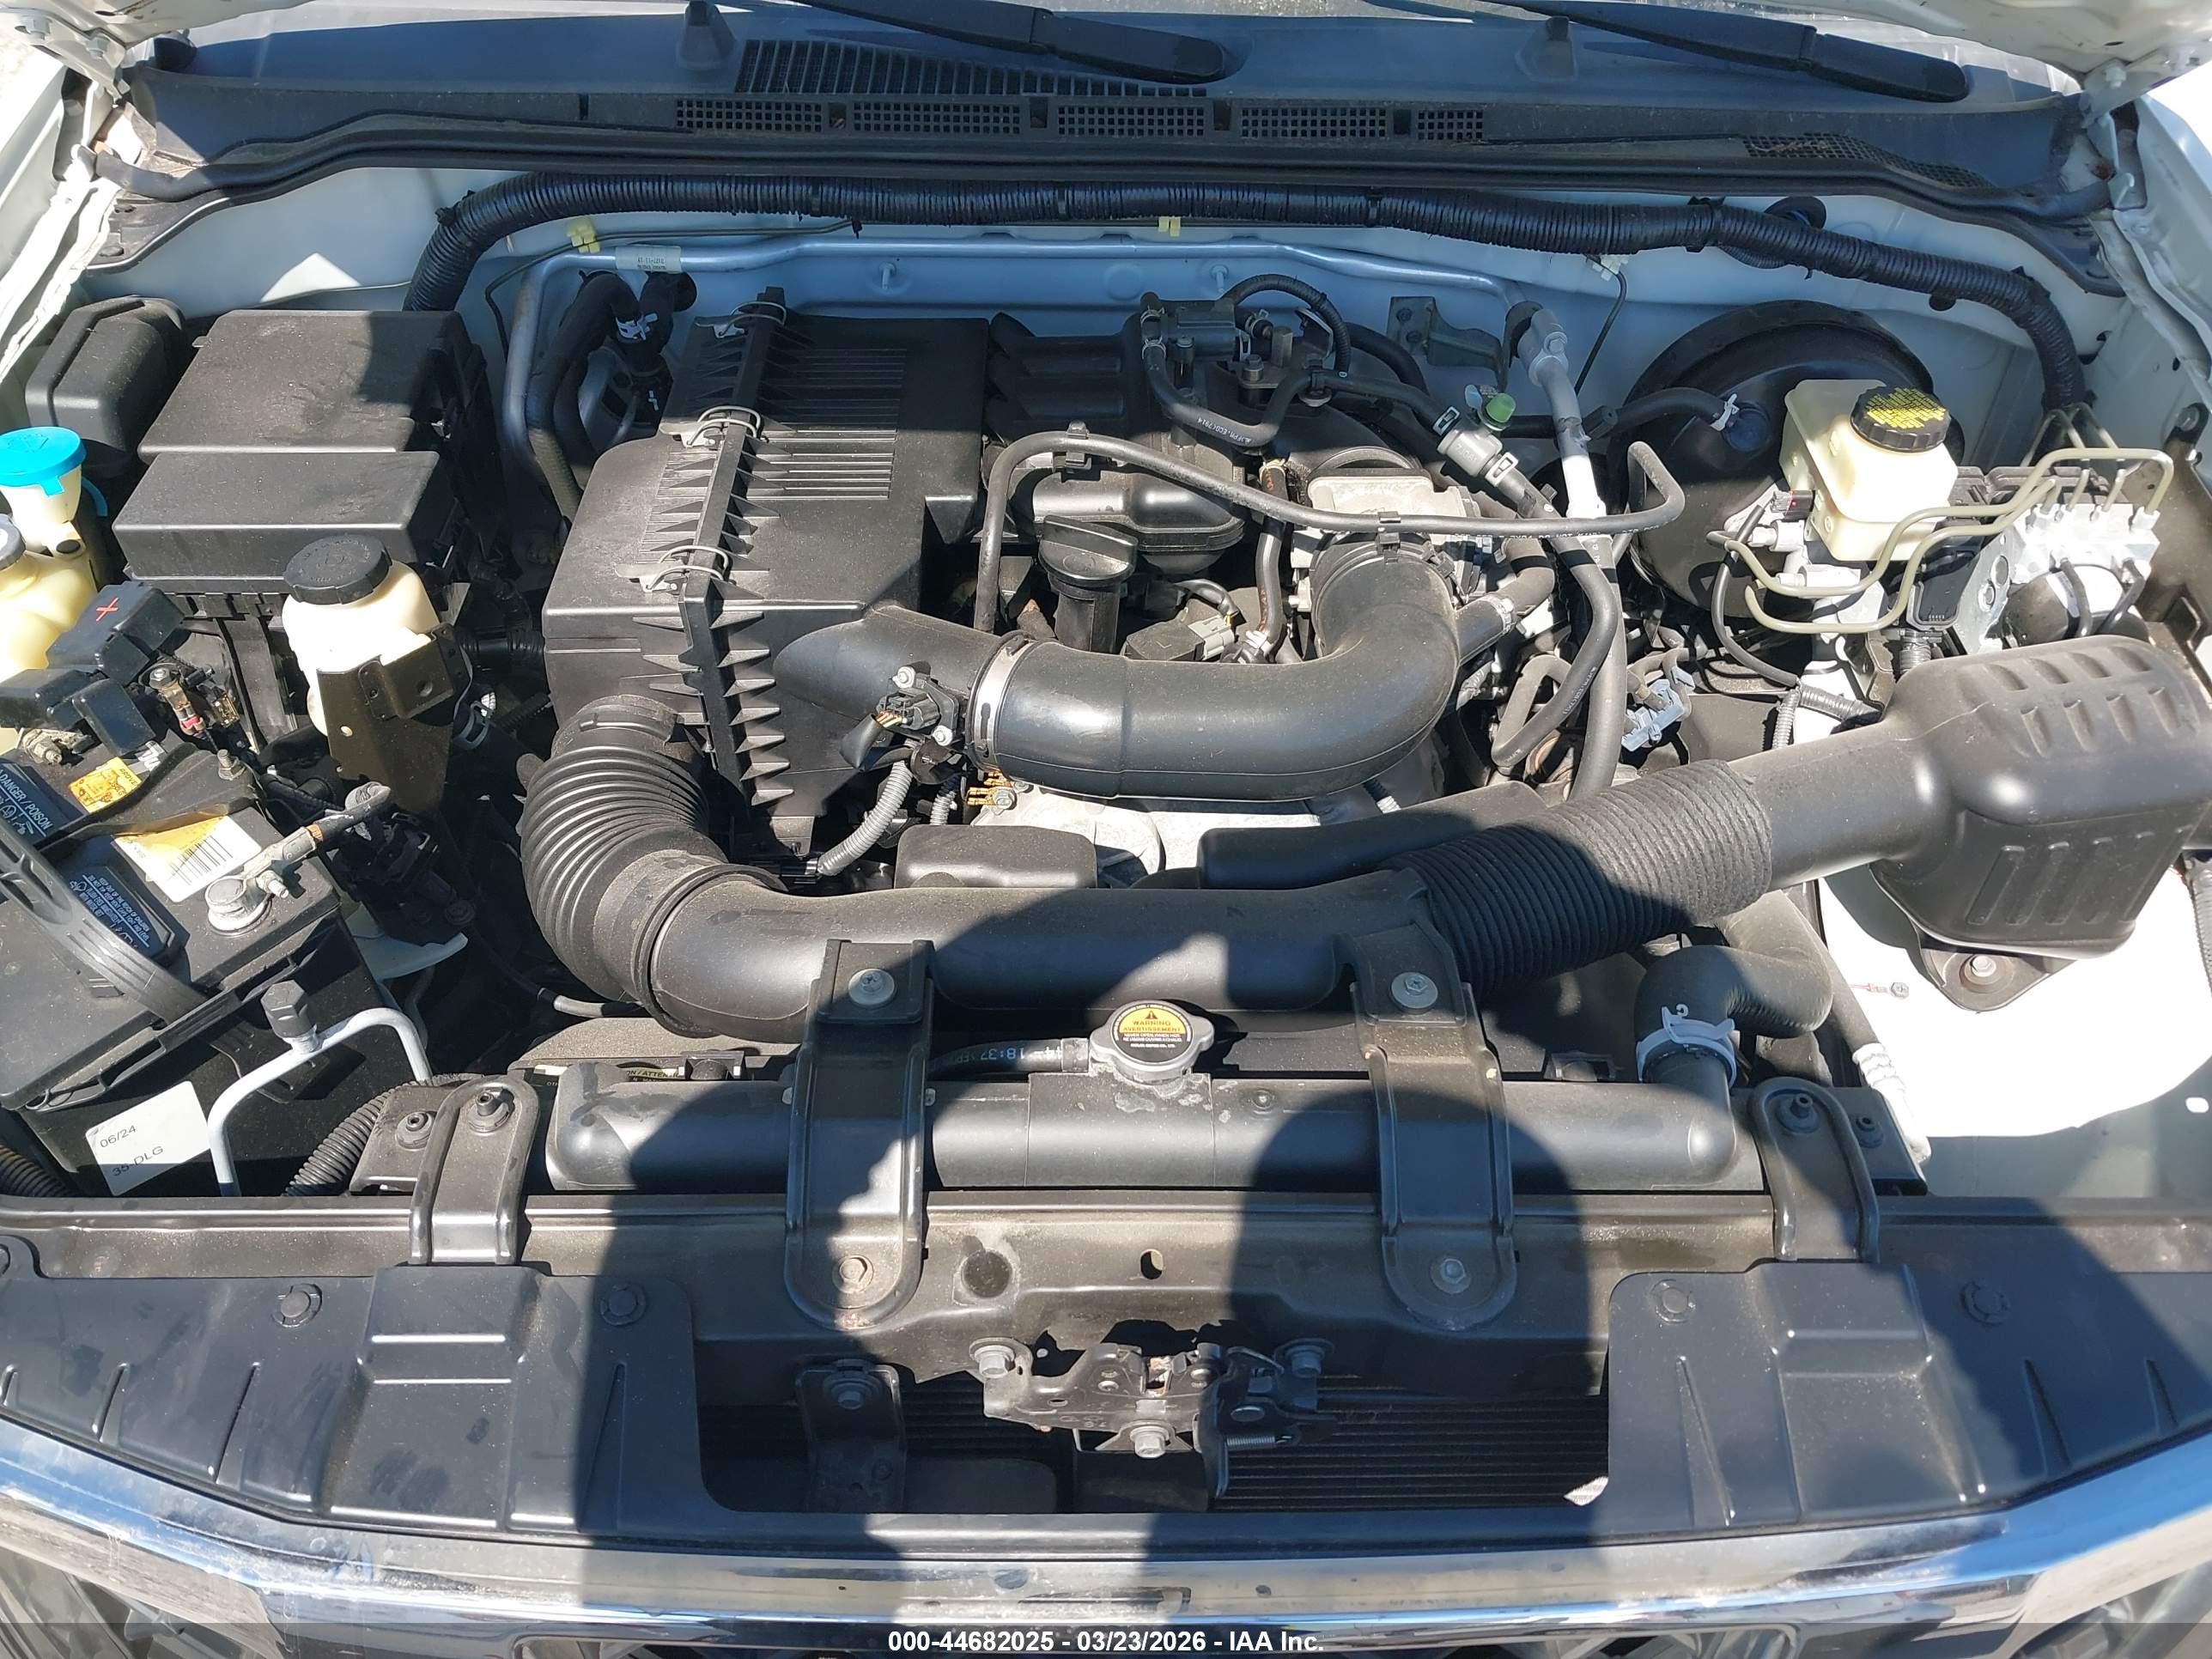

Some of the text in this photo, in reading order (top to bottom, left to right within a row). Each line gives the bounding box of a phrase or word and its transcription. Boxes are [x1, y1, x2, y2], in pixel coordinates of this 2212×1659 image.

[0, 773, 27, 801] DANGER
[24, 802, 53, 831] POISON
[99, 877, 109, 887] KEEP
[106, 884, 114, 893] OUT
[981, 1047, 1024, 1060] 18:37
[100, 1125, 137, 1148] 06/24
[112, 1146, 164, 1176] 35-DLG
